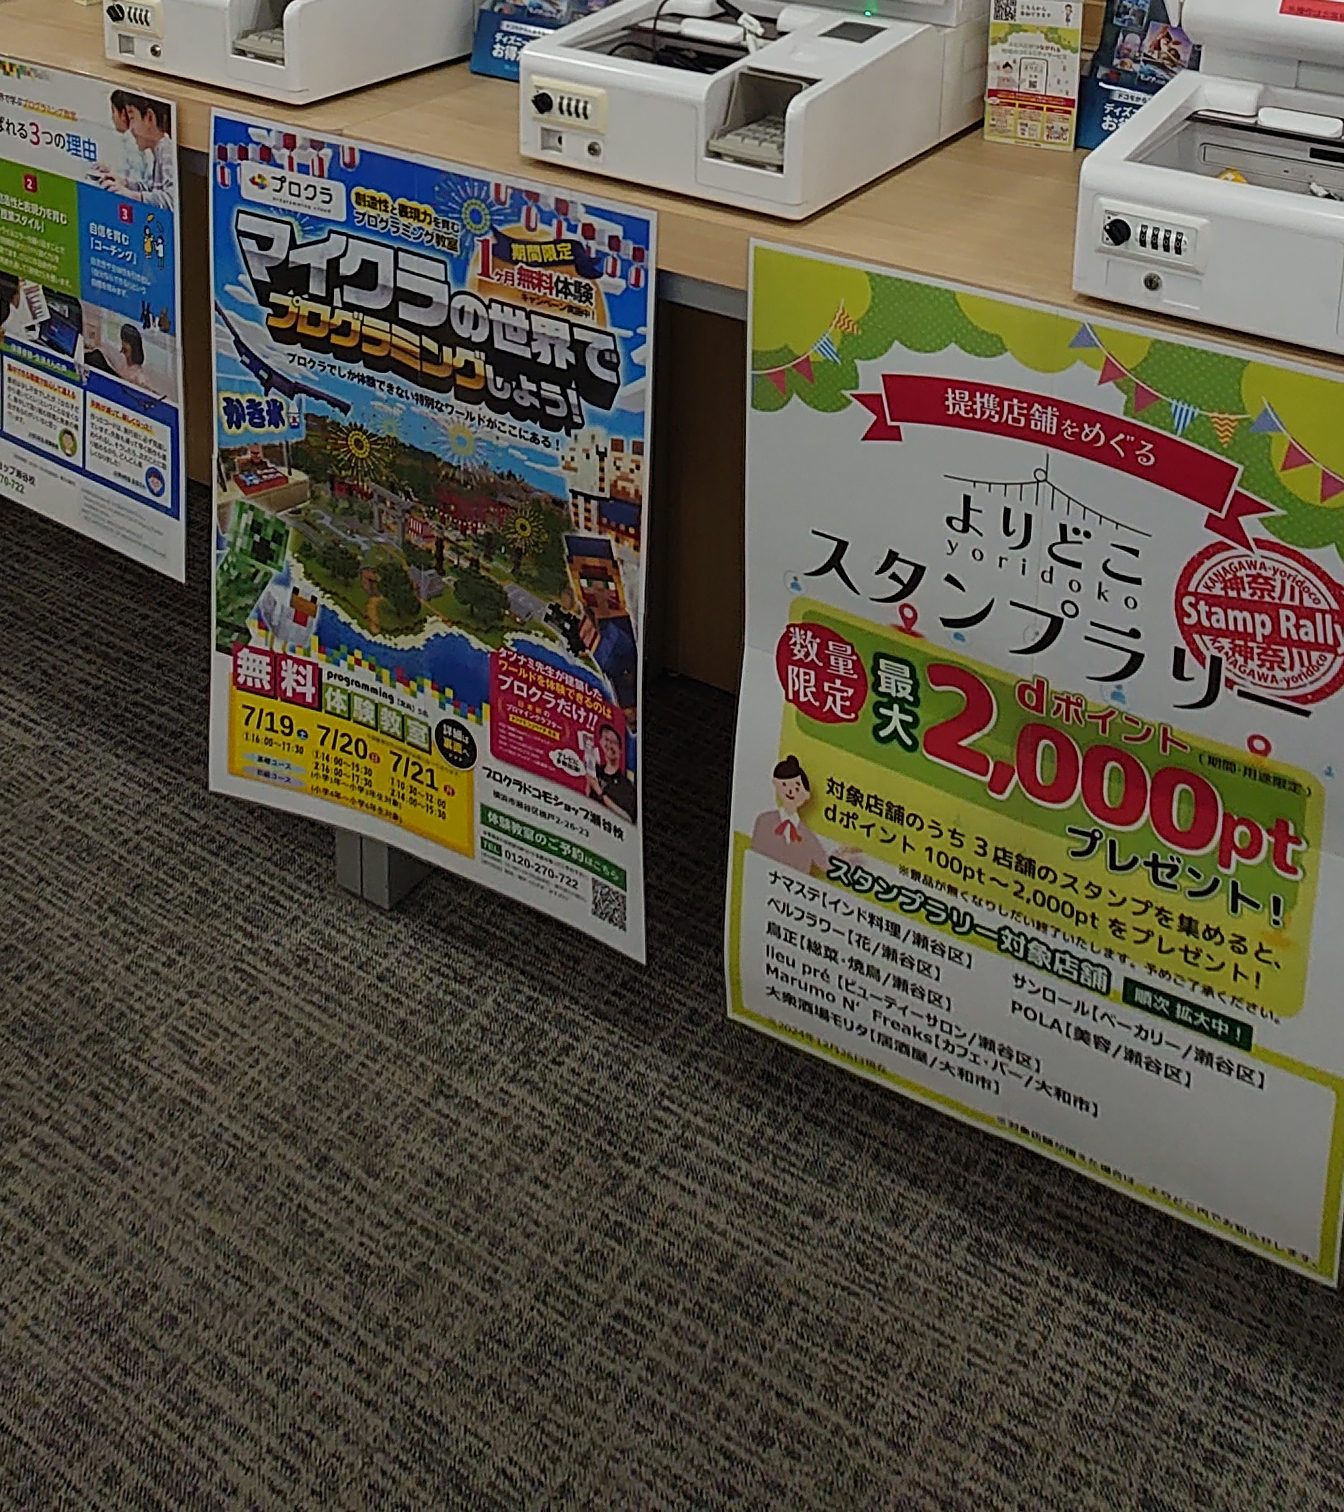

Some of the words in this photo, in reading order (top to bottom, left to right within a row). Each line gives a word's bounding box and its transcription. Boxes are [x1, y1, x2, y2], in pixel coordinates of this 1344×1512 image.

[270, 174, 334, 204] プロクラ
[354, 190, 460, 234] 創造性と表現力を育む
[354, 210, 459, 253] プログラミング教室
[511, 242, 574, 262] 期間限定
[235, 210, 620, 385] マイクラの世界で
[267, 292, 585, 428] プログラミングしよう!
[223, 395, 287, 430] かき氷
[288, 352, 561, 452] プロクラでしか体験できない特別なワールドがここにある!
[943, 386, 1158, 467] 提携店舗をめぐる
[945, 493, 1145, 586] よりどこ
[1202, 560, 1322, 606] KANAGAWA-yoridoco
[1222, 572, 1305, 606] 神奈川
[803, 528, 1312, 719] スタンプラリー
[1181, 595, 1274, 643] Stamp
[236, 647, 315, 704] 無料
[786, 628, 860, 681] 数量
[1231, 639, 1313, 673] 神奈川
[327, 669, 395, 704] programming
[497, 674, 599, 732] プロクラだけ!!
[498, 659, 613, 720] ワールドを体験できるのは
[784, 663, 857, 717] 限定
[876, 656, 918, 752] 最大
[241, 704, 294, 737] 7/19
[316, 724, 368, 761] 7/20
[323, 686, 429, 751] 体験教室
[1014, 677, 1192, 756] dポイント
[389, 750, 439, 792] 7/21
[922, 662, 1306, 879] 2,000pt
[487, 810, 620, 881] 体験教室のご予約はこちら
[504, 849, 579, 890] 0120-270-722
[822, 802, 918, 855] dポイント
[1106, 916, 1264, 991] をプレゼント!
[1065, 825, 1286, 928] プレゼント!
[766, 897, 942, 983] ベルフラワー【花/瀬谷区】
[767, 870, 974, 971] ナマステ【インド料理/瀬谷区】
[825, 855, 1112, 996] スタンプラリー対象店舗
[765, 944, 796, 968] lieu
[802, 962, 831, 984] pré
[765, 963, 836, 1004] Marumo
[1009, 999, 1194, 1090] POLA【美容/瀬谷区】
[1010, 970, 1267, 1091] サンロール【ベーカリー/瀬谷区】
[1133, 987, 1245, 1046] 順次拡大中!
